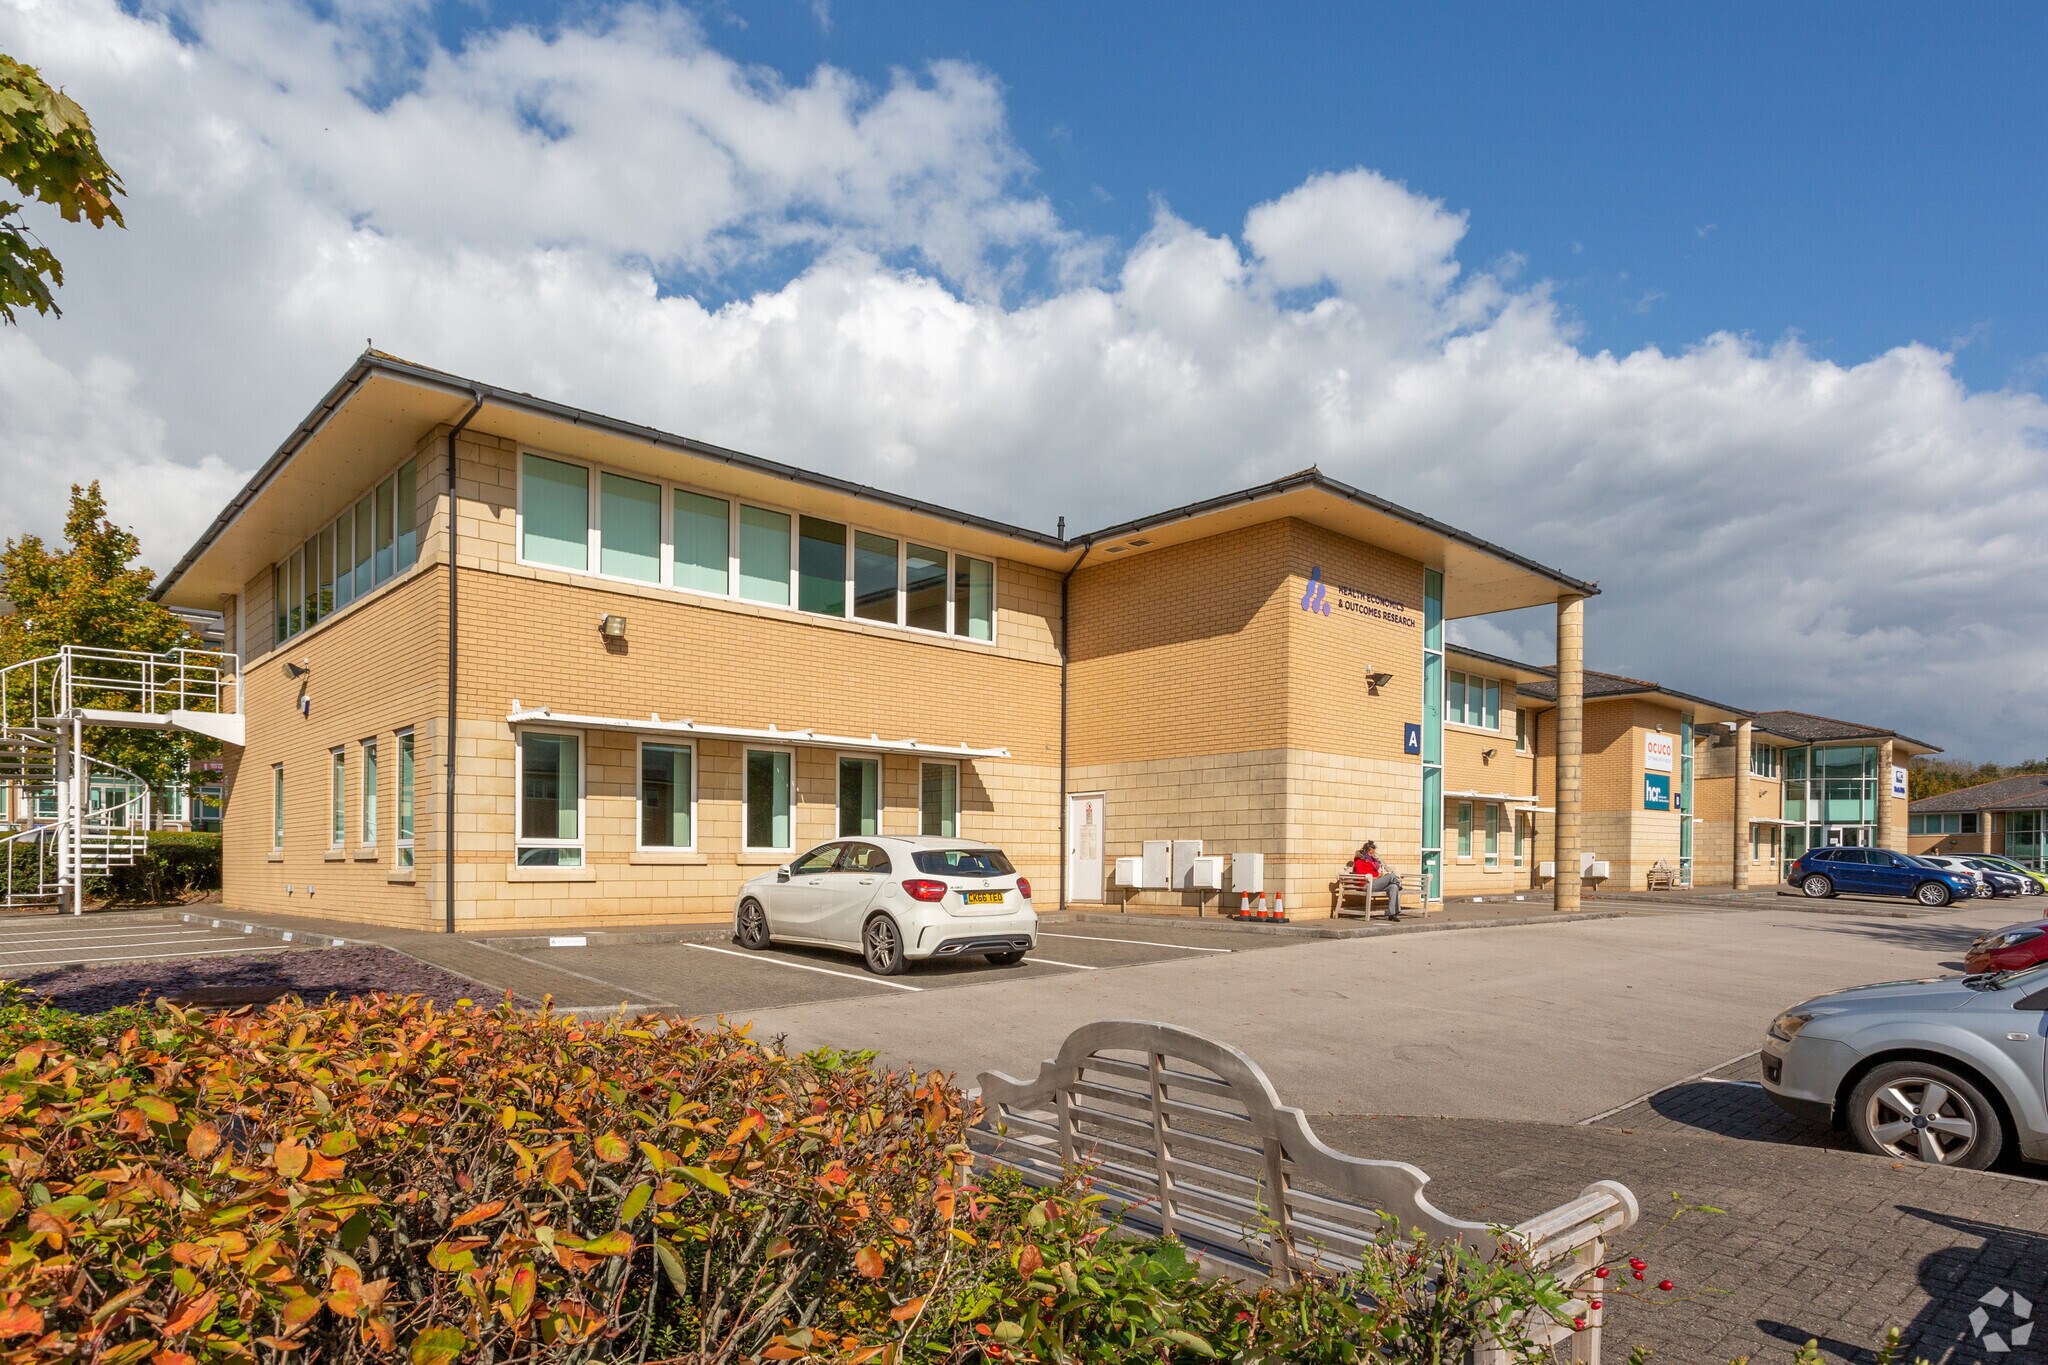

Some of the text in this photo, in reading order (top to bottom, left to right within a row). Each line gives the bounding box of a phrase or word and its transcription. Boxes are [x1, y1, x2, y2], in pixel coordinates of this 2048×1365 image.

[1338, 585, 1405, 612] HEALTH ECONOMICS
[1338, 599, 1416, 628] & OUTCOMES RESEARCH
[1408, 730, 1418, 748] A
[968, 893, 987, 902] CK66
